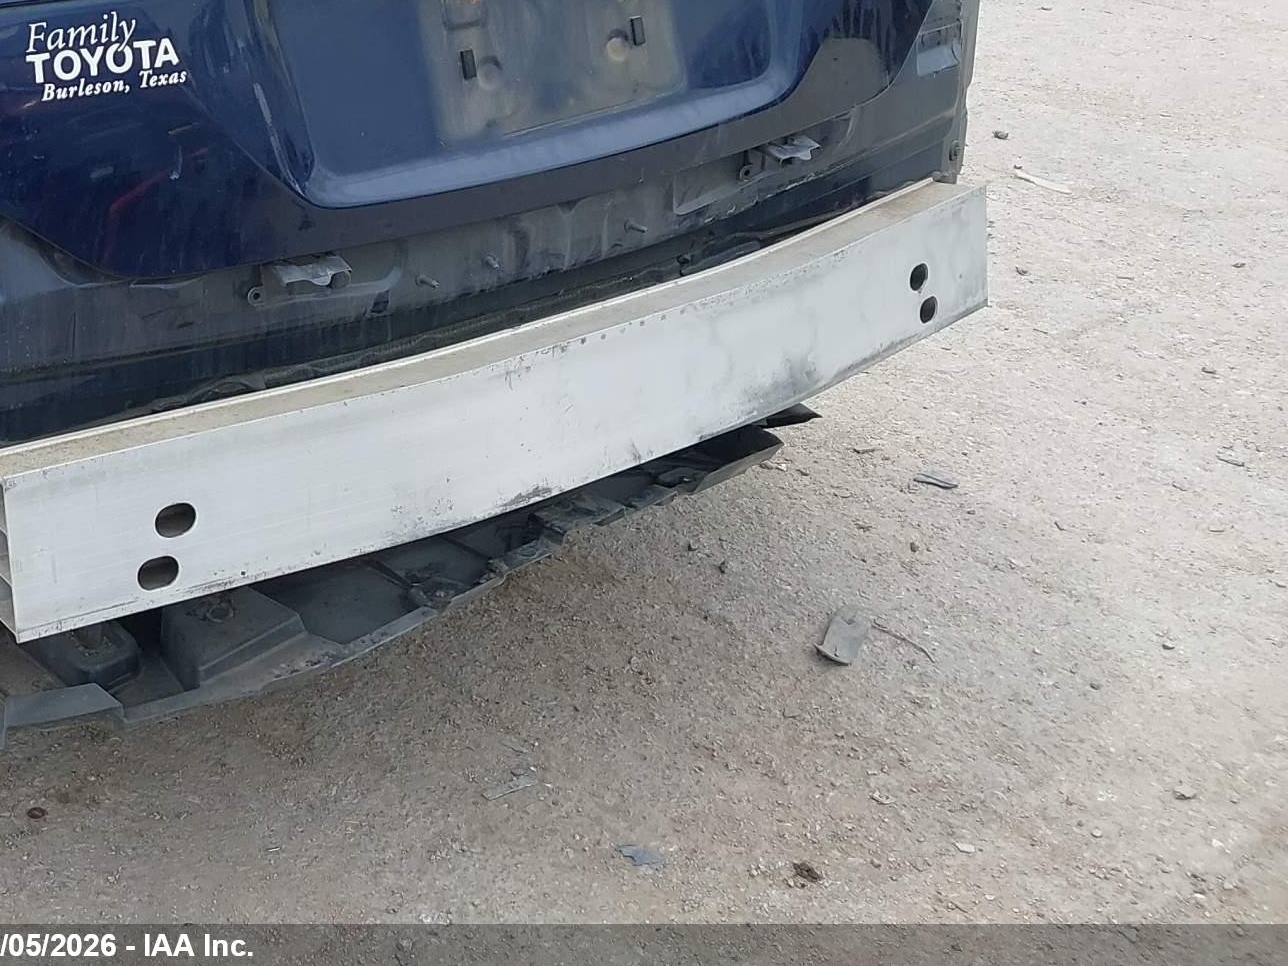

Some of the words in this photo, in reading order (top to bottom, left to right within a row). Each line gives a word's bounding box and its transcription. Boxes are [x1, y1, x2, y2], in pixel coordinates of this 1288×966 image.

[26, 12, 136, 53] Family
[26, 39, 179, 84] TOYOTA
[41, 78, 130, 101] Burleson,
[139, 69, 187, 88] Texas
